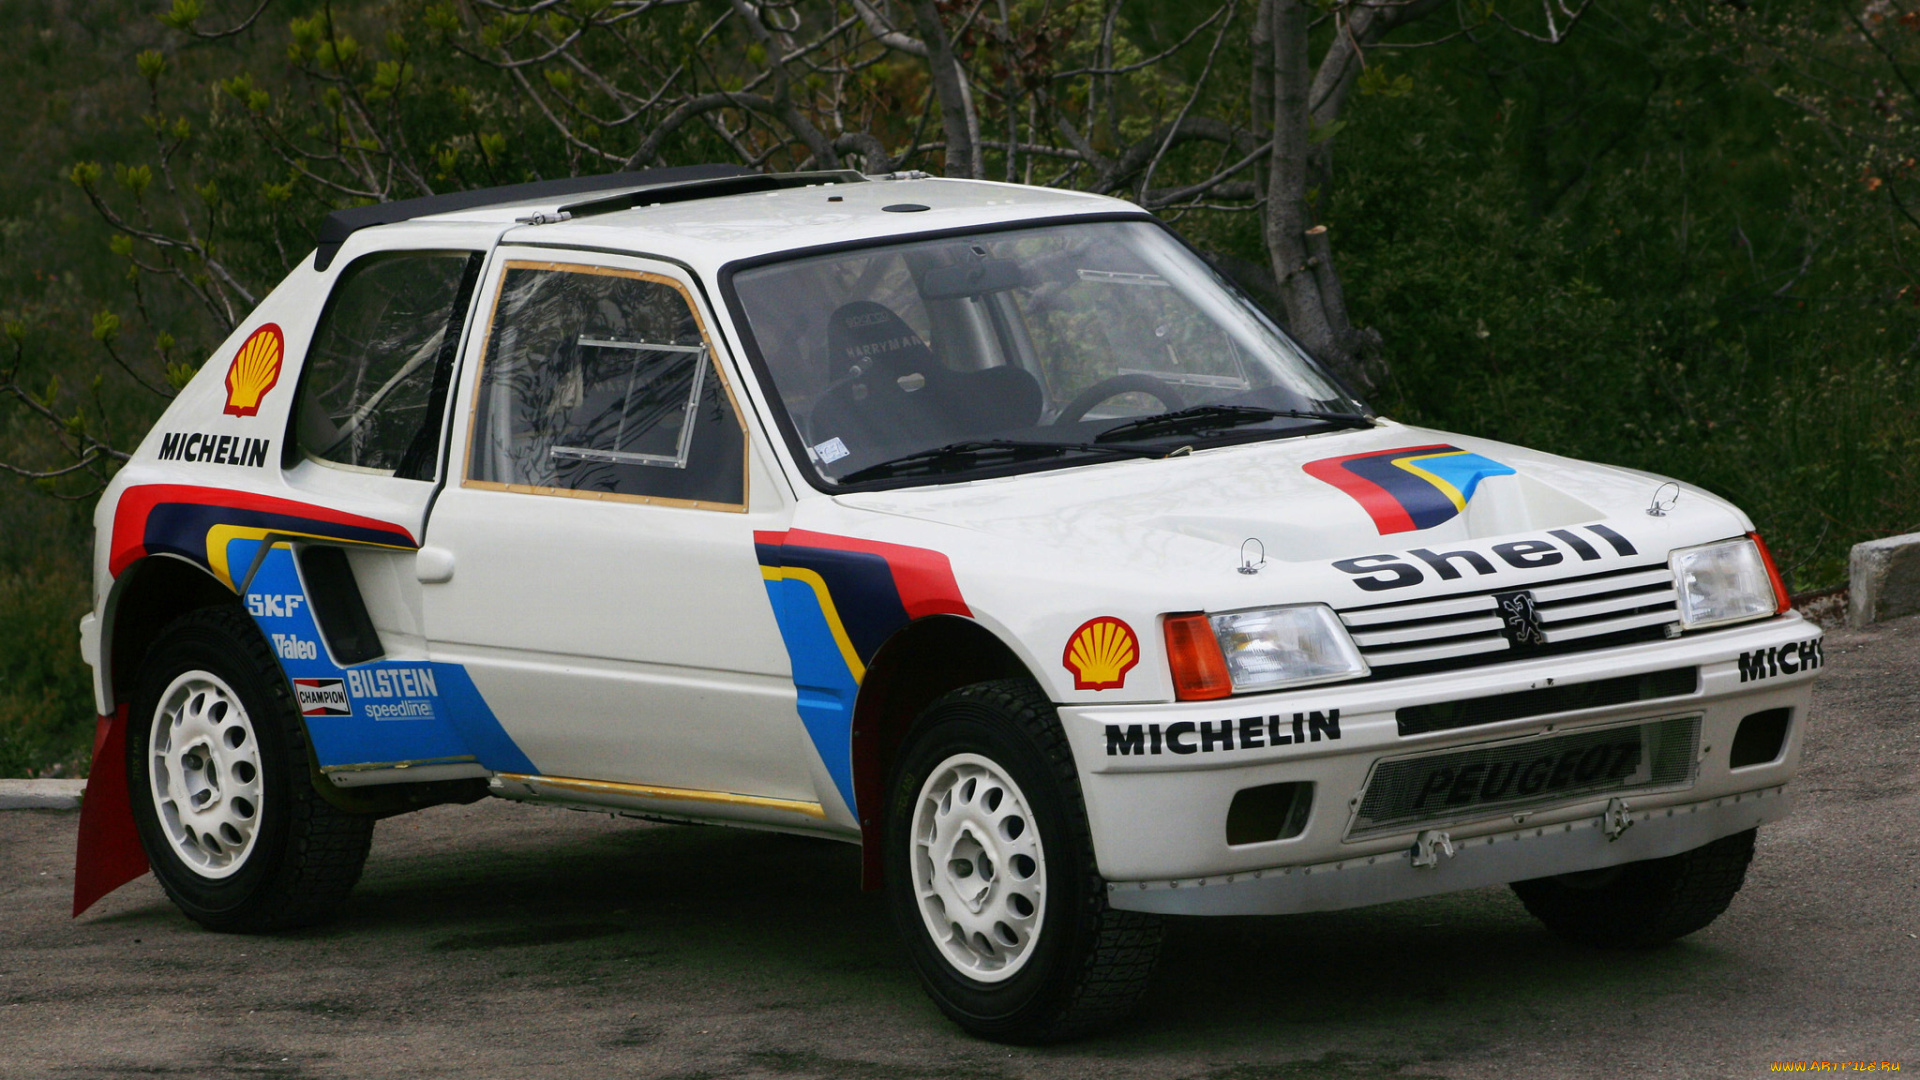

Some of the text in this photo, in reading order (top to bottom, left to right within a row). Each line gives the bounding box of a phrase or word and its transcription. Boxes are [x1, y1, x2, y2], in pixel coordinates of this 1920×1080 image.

[158, 432, 270, 468] MICHELIN
[1331, 524, 1639, 592] Shell
[248, 594, 304, 617] SKF
[271, 633, 317, 660] Valeo
[299, 691, 346, 704] CHAMPION
[347, 668, 438, 698] BILSTEIN
[365, 701, 432, 721] speedline
[1105, 709, 1341, 756] MICHELIN
[1413, 741, 1641, 809] PEUGEOT
